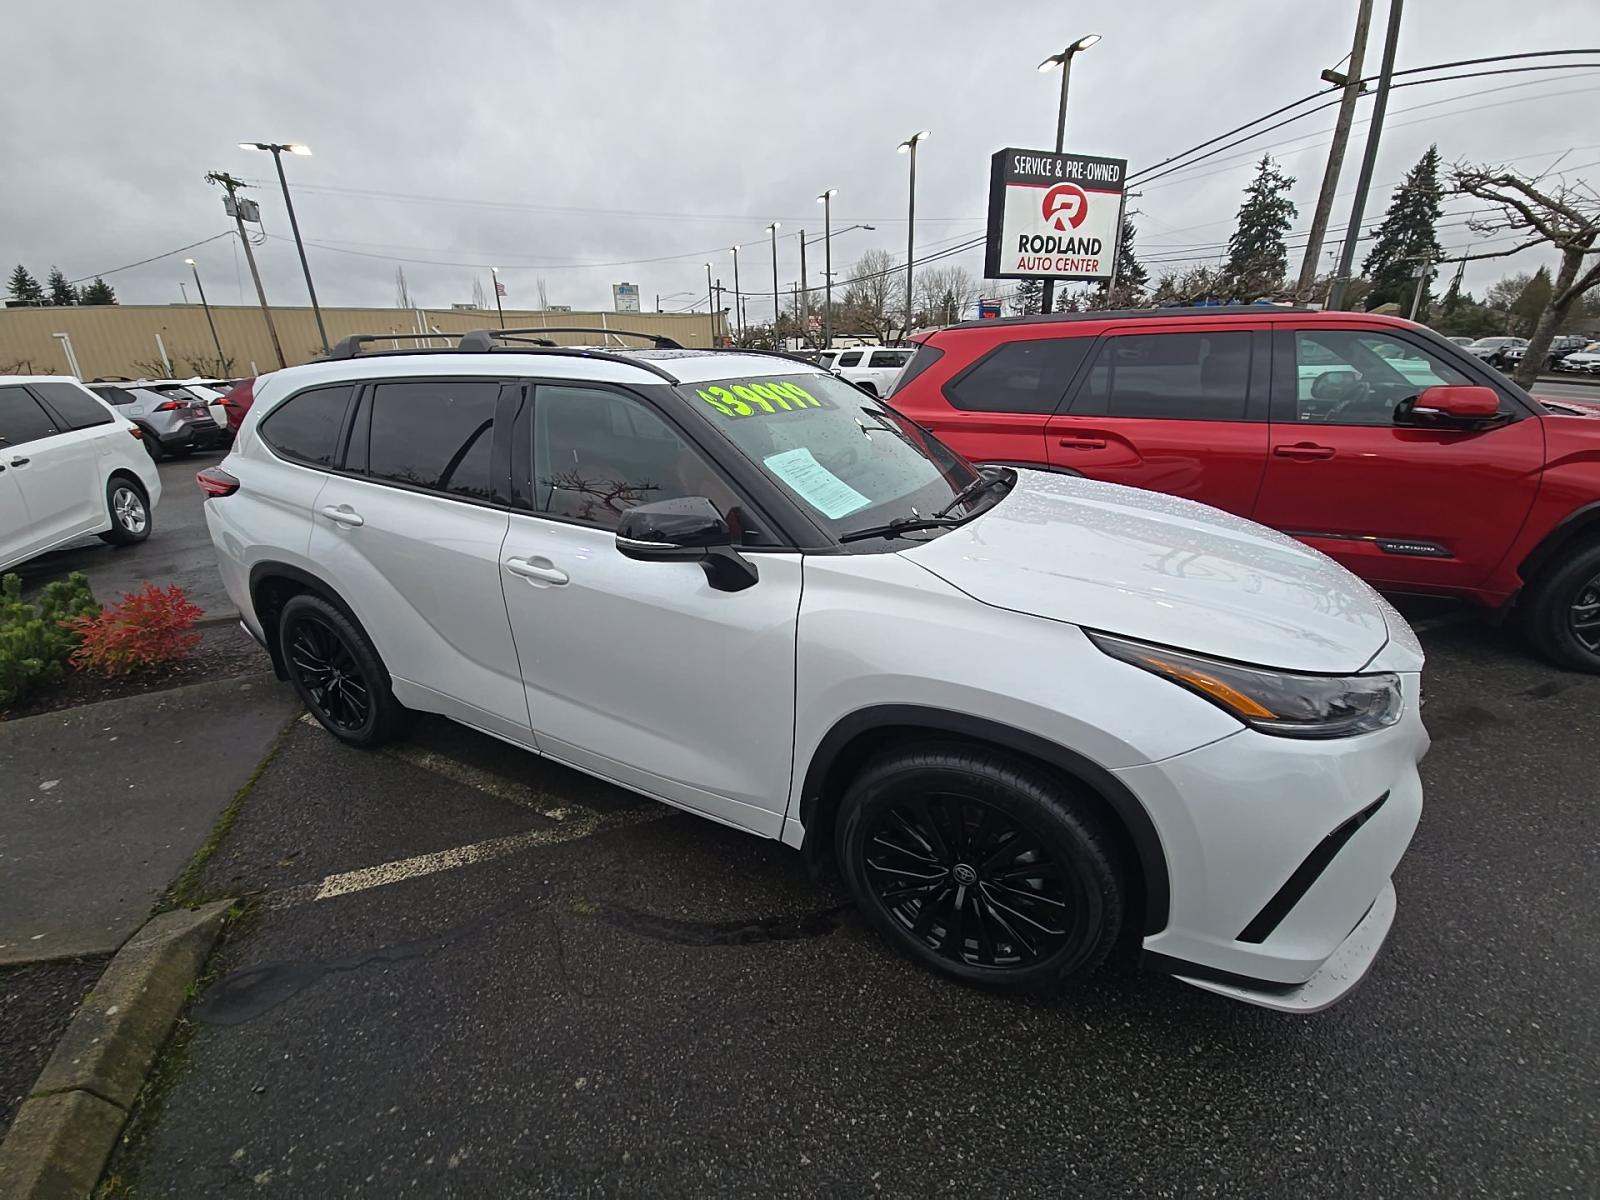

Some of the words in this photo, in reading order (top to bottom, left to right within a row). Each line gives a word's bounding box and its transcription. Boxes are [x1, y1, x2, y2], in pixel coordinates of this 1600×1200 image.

[1014, 155, 1052, 176] SERVICE
[1055, 160, 1063, 178] &
[1066, 160, 1120, 182] PRE-OWNED
[1046, 193, 1082, 231] R
[1018, 234, 1102, 256] RODLAND
[1017, 256, 1052, 271] AUTO
[1055, 257, 1099, 273] CENTER
[695, 381, 821, 417] $39999
[1386, 544, 1436, 552] PLATINUM
